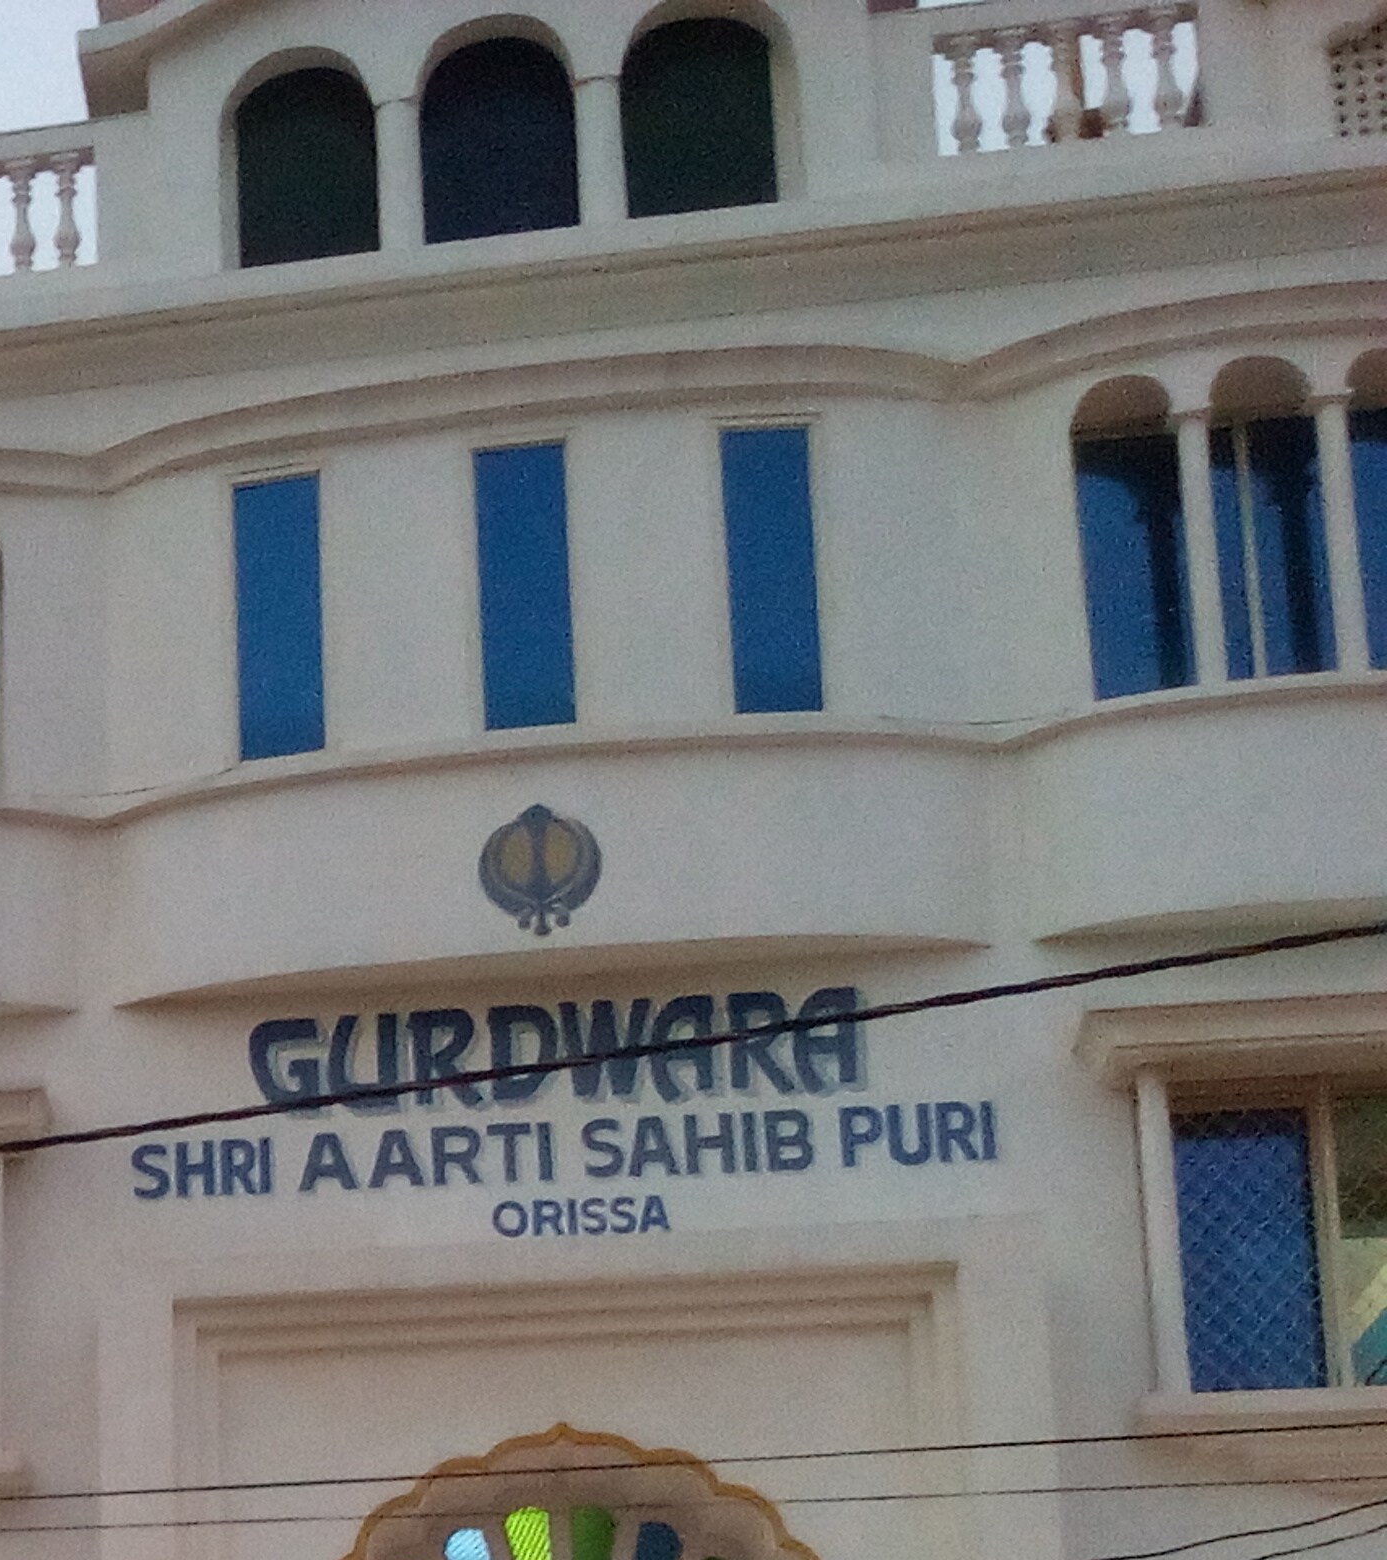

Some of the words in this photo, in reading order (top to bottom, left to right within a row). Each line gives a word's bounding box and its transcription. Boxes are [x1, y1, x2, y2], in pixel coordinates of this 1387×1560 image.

[248, 986, 867, 1112] GURDWARA
[130, 1138, 272, 1200] SHRI
[299, 1121, 555, 1193] AARTI
[582, 1108, 814, 1179] SAHIB
[838, 1099, 998, 1169] PURI
[492, 1195, 671, 1238] ORISSA
